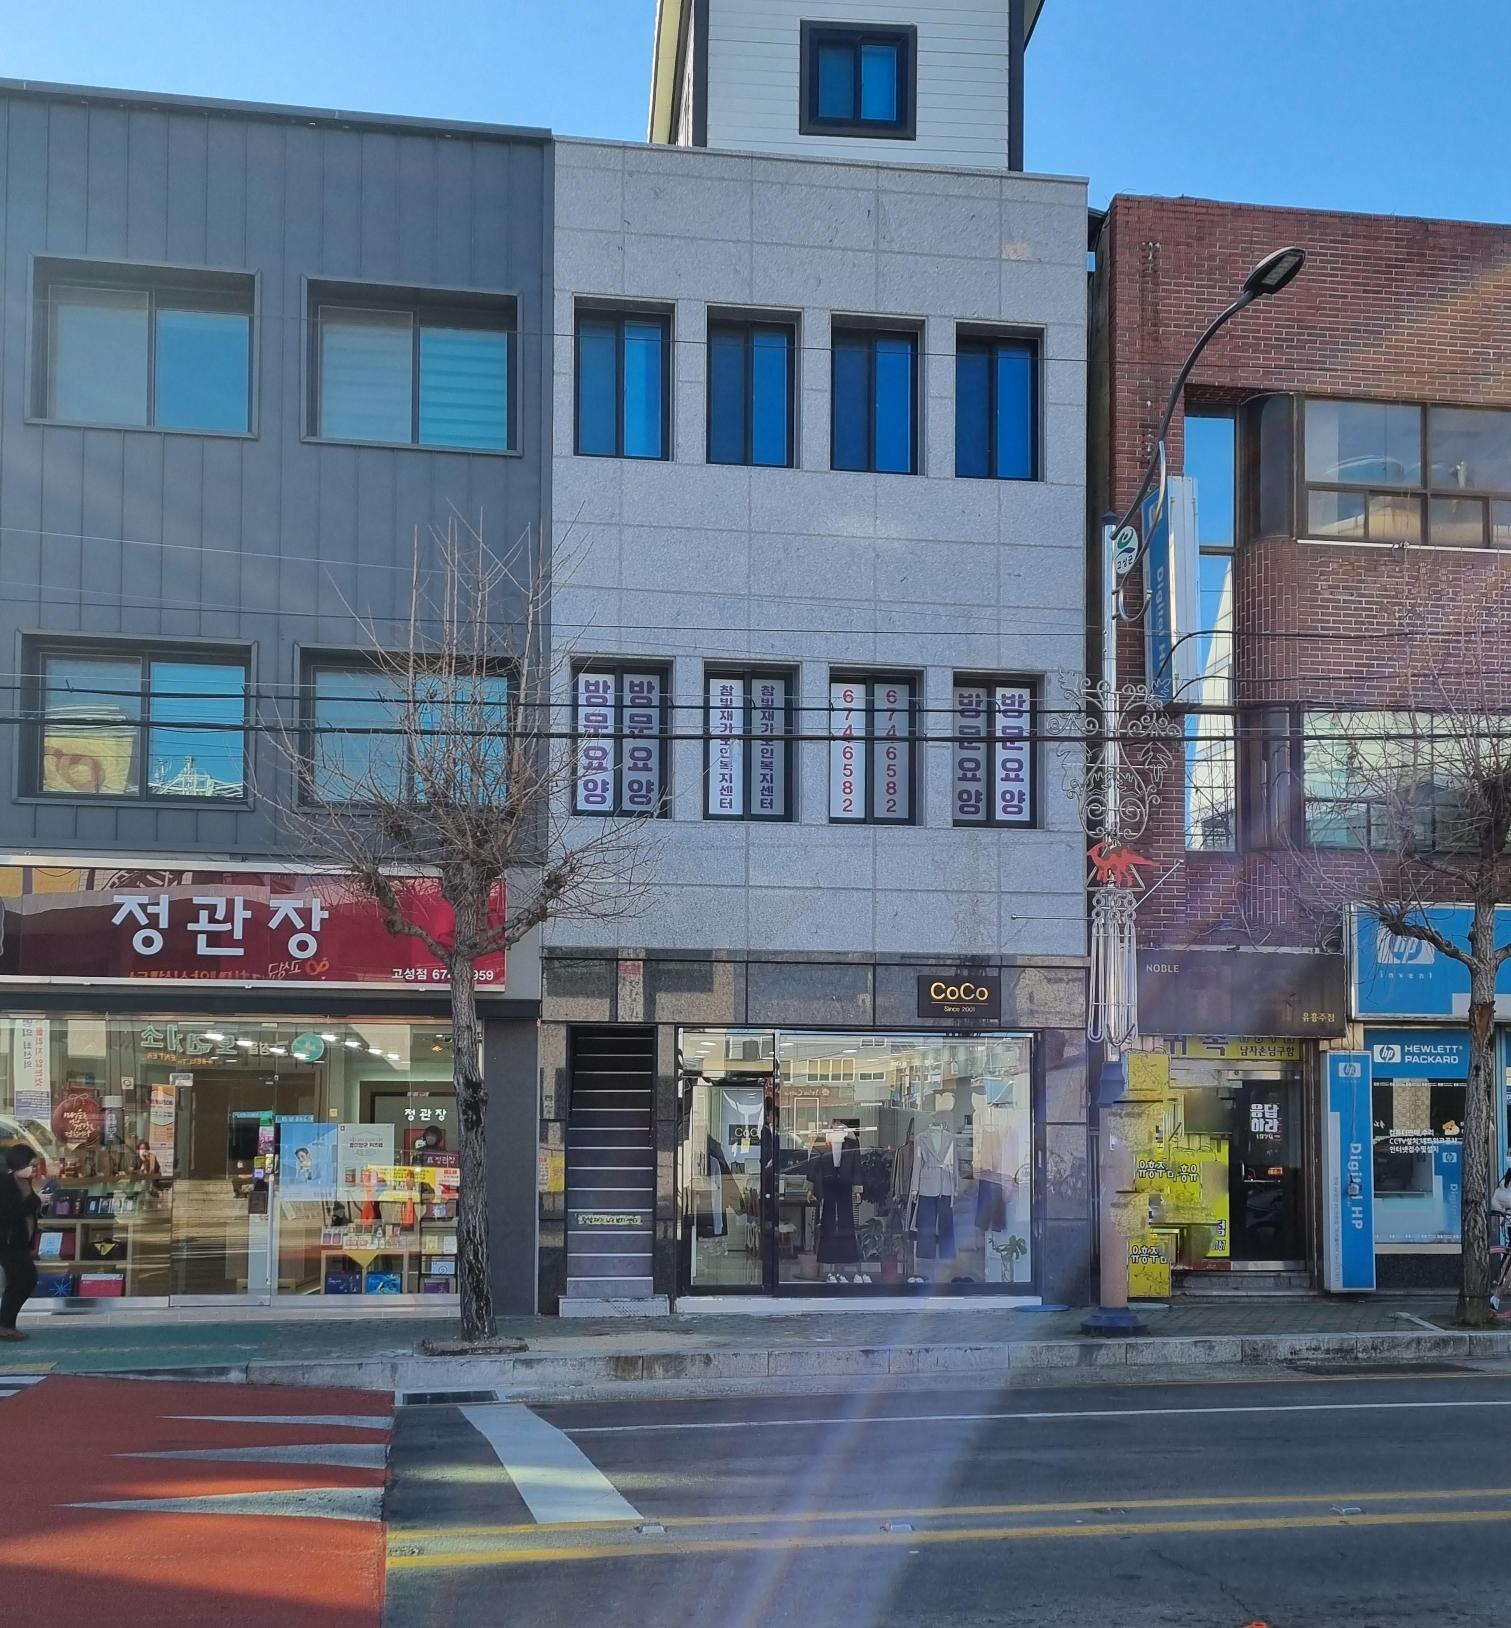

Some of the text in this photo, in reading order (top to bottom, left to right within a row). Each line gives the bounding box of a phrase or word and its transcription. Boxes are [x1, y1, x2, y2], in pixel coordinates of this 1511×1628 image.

[842, 689, 854, 813] 6746582
[885, 689, 898, 813] 6746582
[110, 893, 330, 961] 정관장
[391, 968, 428, 980] 고성점
[1146, 963, 1181, 973] NOBLE
[930, 982, 989, 1000] CoCo
[1404, 1045, 1458, 1054] HEWLETT
[1404, 1055, 1459, 1064] PACKARD
[404, 1108, 448, 1121] 정관장
[1250, 1103, 1280, 1118] 응답
[1250, 1118, 1280, 1132] 하라
[1351, 1206, 1364, 1230] HP
